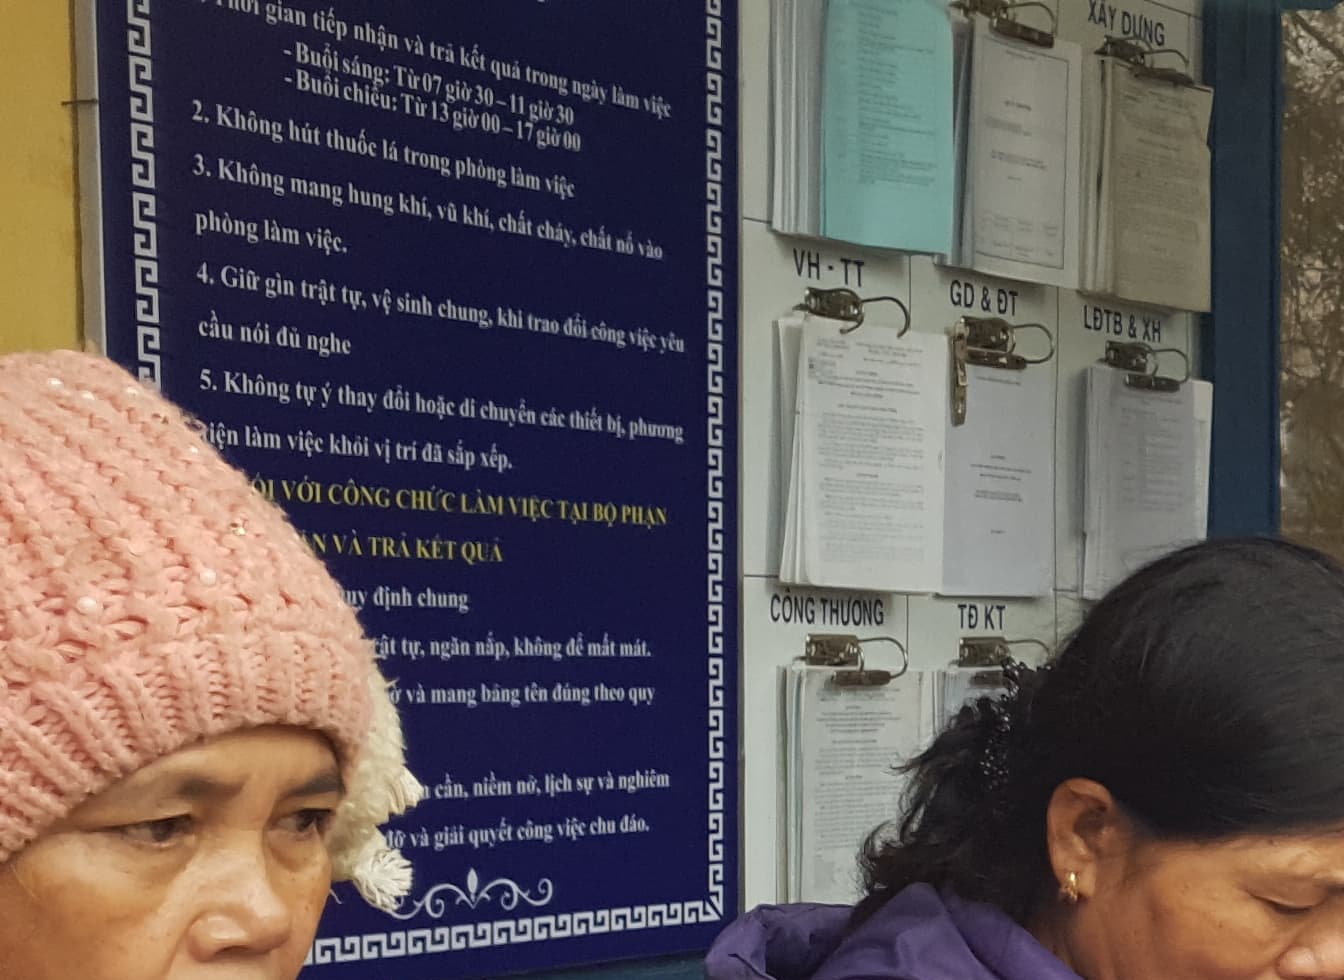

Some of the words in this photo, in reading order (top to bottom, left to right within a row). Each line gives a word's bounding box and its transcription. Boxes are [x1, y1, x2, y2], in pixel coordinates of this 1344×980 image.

[265, 2, 307, 26] gian
[313, 8, 348, 40] tiếp
[354, 25, 398, 51] nhận
[404, 35, 424, 56] và
[430, 40, 455, 64] trả
[460, 43, 486, 71] kết
[491, 60, 521, 81] quả
[526, 65, 568, 96] trong
[572, 79, 608, 106] ngày
[612, 84, 640, 110] làm
[643, 95, 672, 120] việc
[296, 42, 338, 71] Buổi
[343, 55, 389, 86] sáng:
[393, 65, 420, 90] Từ
[422, 73, 442, 94] 07
[446, 80, 472, 103] giờ
[475, 85, 493, 107] 30
[510, 94, 525, 115] 11
[529, 100, 551, 122] giờ
[555, 105, 574, 126] 30
[343, 81, 397, 111] chiều:
[400, 92, 427, 120] Từ
[432, 101, 448, 122] 13
[453, 105, 478, 130] giờ
[481, 112, 500, 134] 00
[517, 120, 533, 142] 17
[537, 128, 560, 149] giờ
[563, 133, 581, 151] 00
[192, 99, 209, 123] 2.
[216, 104, 283, 143] Không
[289, 119, 320, 145] hút
[327, 128, 377, 157] thuốc
[383, 139, 398, 161] lá
[404, 146, 450, 177] trong
[455, 157, 507, 189] phòng
[511, 166, 540, 191] làm
[545, 175, 575, 200] việc
[193, 154, 211, 177] 3.
[218, 158, 285, 196] Không
[291, 176, 343, 207] mang
[349, 182, 394, 216] hung
[400, 192, 432, 220] khí,
[437, 203, 457, 223] vũ
[463, 204, 494, 230] khí,
[498, 210, 532, 236] chất
[537, 221, 577, 247] cháy,
[580, 225, 612, 250] chất
[638, 239, 663, 259] vào
[195, 209, 259, 244] phòng
[264, 219, 300, 245] làm
[305, 228, 347, 255] việc.
[794, 249, 820, 277] VH
[840, 259, 865, 288] TT
[196, 261, 214, 285] 4.
[220, 265, 260, 291] Giữ
[265, 272, 294, 298] gìn
[301, 279, 336, 306] trật
[342, 287, 367, 311] tự,
[372, 288, 391, 315] vệ
[396, 292, 433, 317] sinh
[438, 300, 493, 329] chung,
[498, 306, 523, 329] khi
[527, 312, 560, 335] trao
[591, 321, 626, 348] công
[628, 328, 657, 352] việc
[660, 332, 684, 354] yêu
[949, 280, 975, 307] GD
[980, 285, 992, 310] &
[996, 289, 1018, 317] ĐT
[198, 309, 233, 341] cầu
[240, 322, 270, 345] nói
[307, 332, 351, 358] nghe
[1084, 306, 1123, 336] LĐTB
[1141, 317, 1161, 344] XH
[200, 368, 217, 391] 5.
[224, 370, 290, 404] Không
[296, 381, 317, 407] tự
[321, 382, 332, 408] ý
[338, 384, 377, 413] thay
[415, 391, 455, 420] hoặc
[480, 398, 536, 427] chuyển
[540, 407, 565, 428] các
[570, 406, 602, 431] thiết
[607, 414, 625, 439] bị,
[629, 417, 684, 444] phương
[245, 425, 281, 450] làm
[287, 430, 324, 458] việc
[330, 432, 369, 457] khỏi
[374, 439, 391, 464] vị
[396, 440, 417, 462] trí
[422, 442, 443, 463] đã
[480, 442, 513, 473] xếp.
[281, 475, 322, 503] VỚI
[328, 479, 391, 508] CÔNG
[395, 485, 456, 514] CHỨC
[460, 489, 503, 515] LÀM
[508, 496, 554, 522] VIỆC
[559, 500, 588, 525] TẠI
[593, 502, 618, 527] BỘ
[333, 529, 362, 556] VÀ
[368, 533, 412, 558] TRẢ
[416, 534, 457, 560] KẾT
[461, 537, 503, 566] QUẢ
[373, 586, 412, 611] định
[418, 588, 469, 614] chung
[770, 588, 816, 626] CÔNG
[958, 604, 978, 629] TĐ
[984, 604, 1005, 631] KT
[401, 637, 425, 661] tự,
[430, 637, 471, 661] ngăn
[514, 636, 563, 661] không
[587, 633, 616, 658] mất
[619, 638, 652, 658] mát.
[407, 684, 426, 704] và
[431, 687, 477, 709] mang
[481, 683, 521, 708] bảng
[524, 682, 549, 704] tên
[552, 683, 591, 707] đúng
[594, 682, 625, 703] theo
[628, 686, 655, 706] quy
[435, 774, 469, 799] cần,
[473, 771, 512, 797] niềm
[545, 774, 572, 797] lịch
[577, 776, 593, 796] sự
[598, 772, 614, 790] và
[618, 769, 670, 792] nghiêm
[410, 827, 429, 847] và
[468, 817, 513, 848] quyết
[517, 820, 553, 843] công
[557, 817, 586, 840] việc
[589, 815, 616, 835] chu
